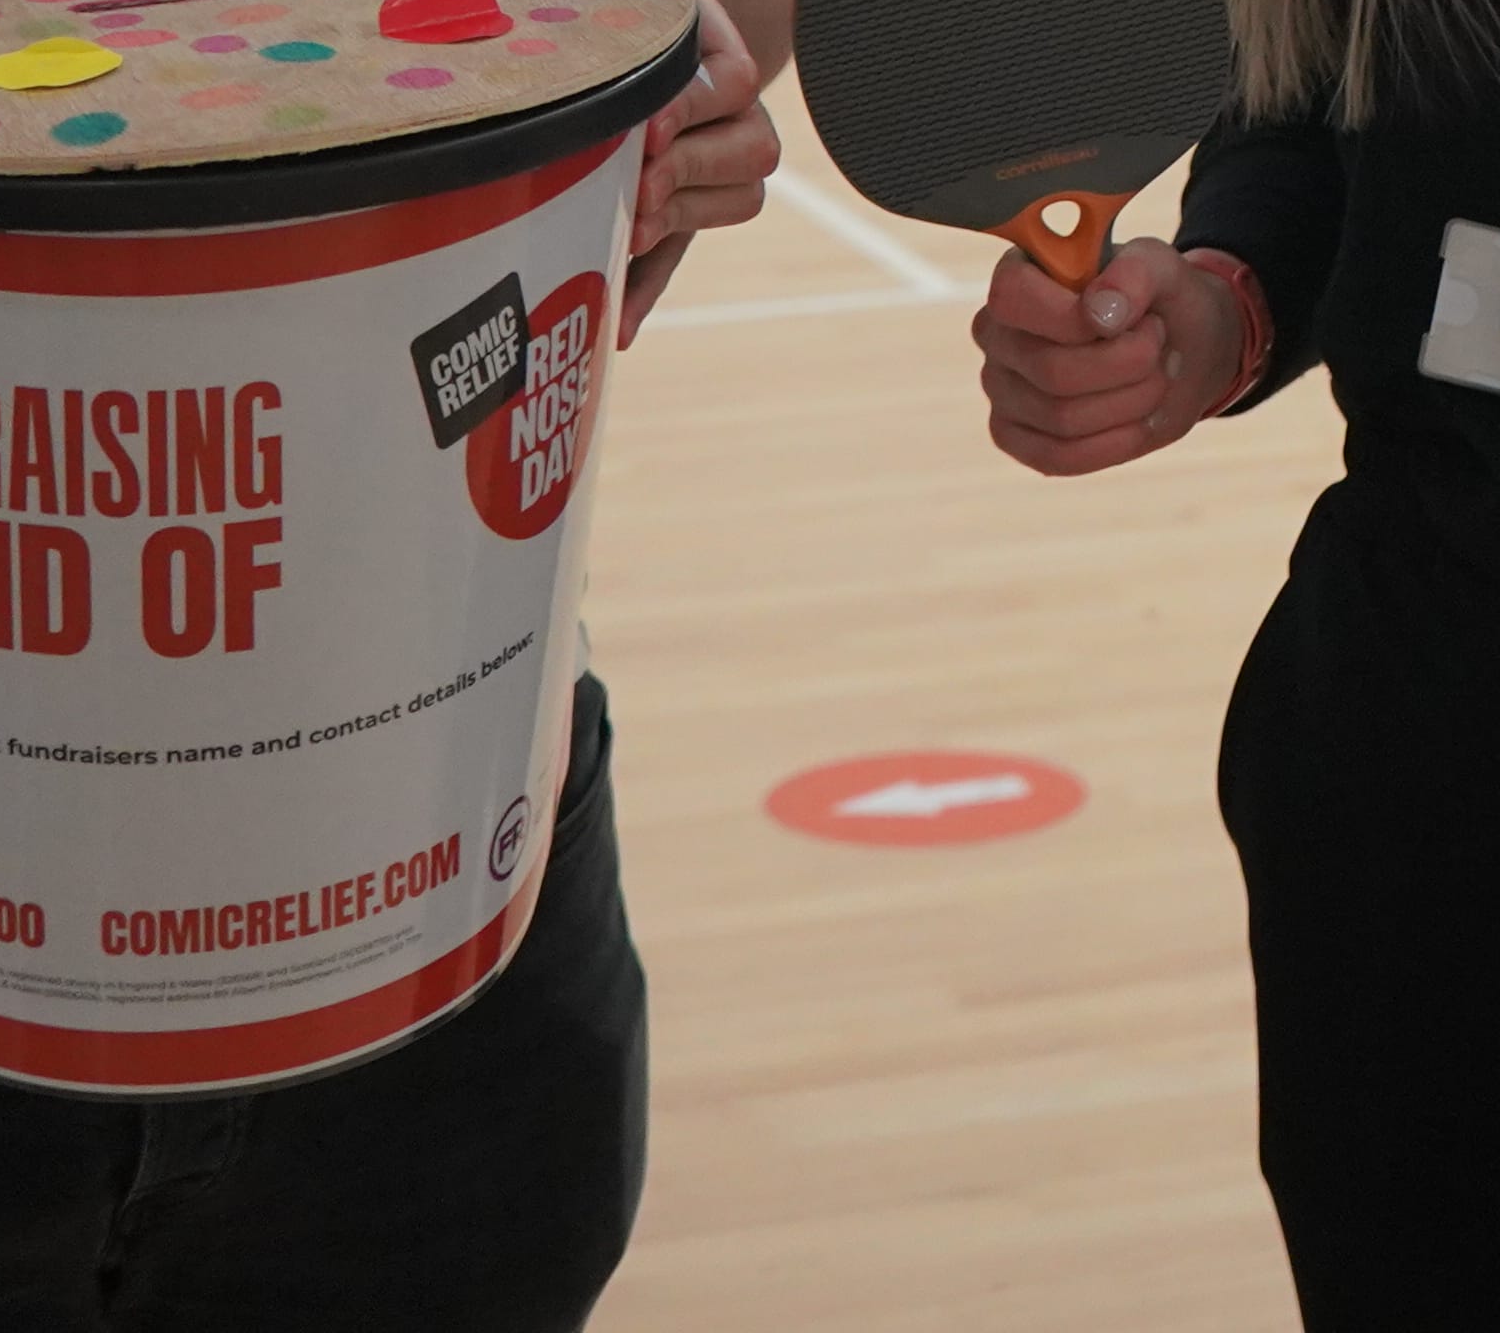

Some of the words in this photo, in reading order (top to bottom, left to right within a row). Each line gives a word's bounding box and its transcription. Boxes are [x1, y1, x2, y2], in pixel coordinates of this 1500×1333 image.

[429, 305, 518, 388] COMIC
[436, 332, 520, 419] RELIEF
[524, 303, 589, 397] RED
[509, 348, 593, 463] NOSE
[520, 412, 581, 513] DAY
[140, 515, 283, 659] OF
[6, 737, 158, 766] fundraisers
[166, 743, 243, 765] name
[251, 730, 301, 756] and
[308, 704, 402, 745] contact
[407, 670, 476, 714] details
[100, 831, 462, 958] COMICRELIEF.COM
